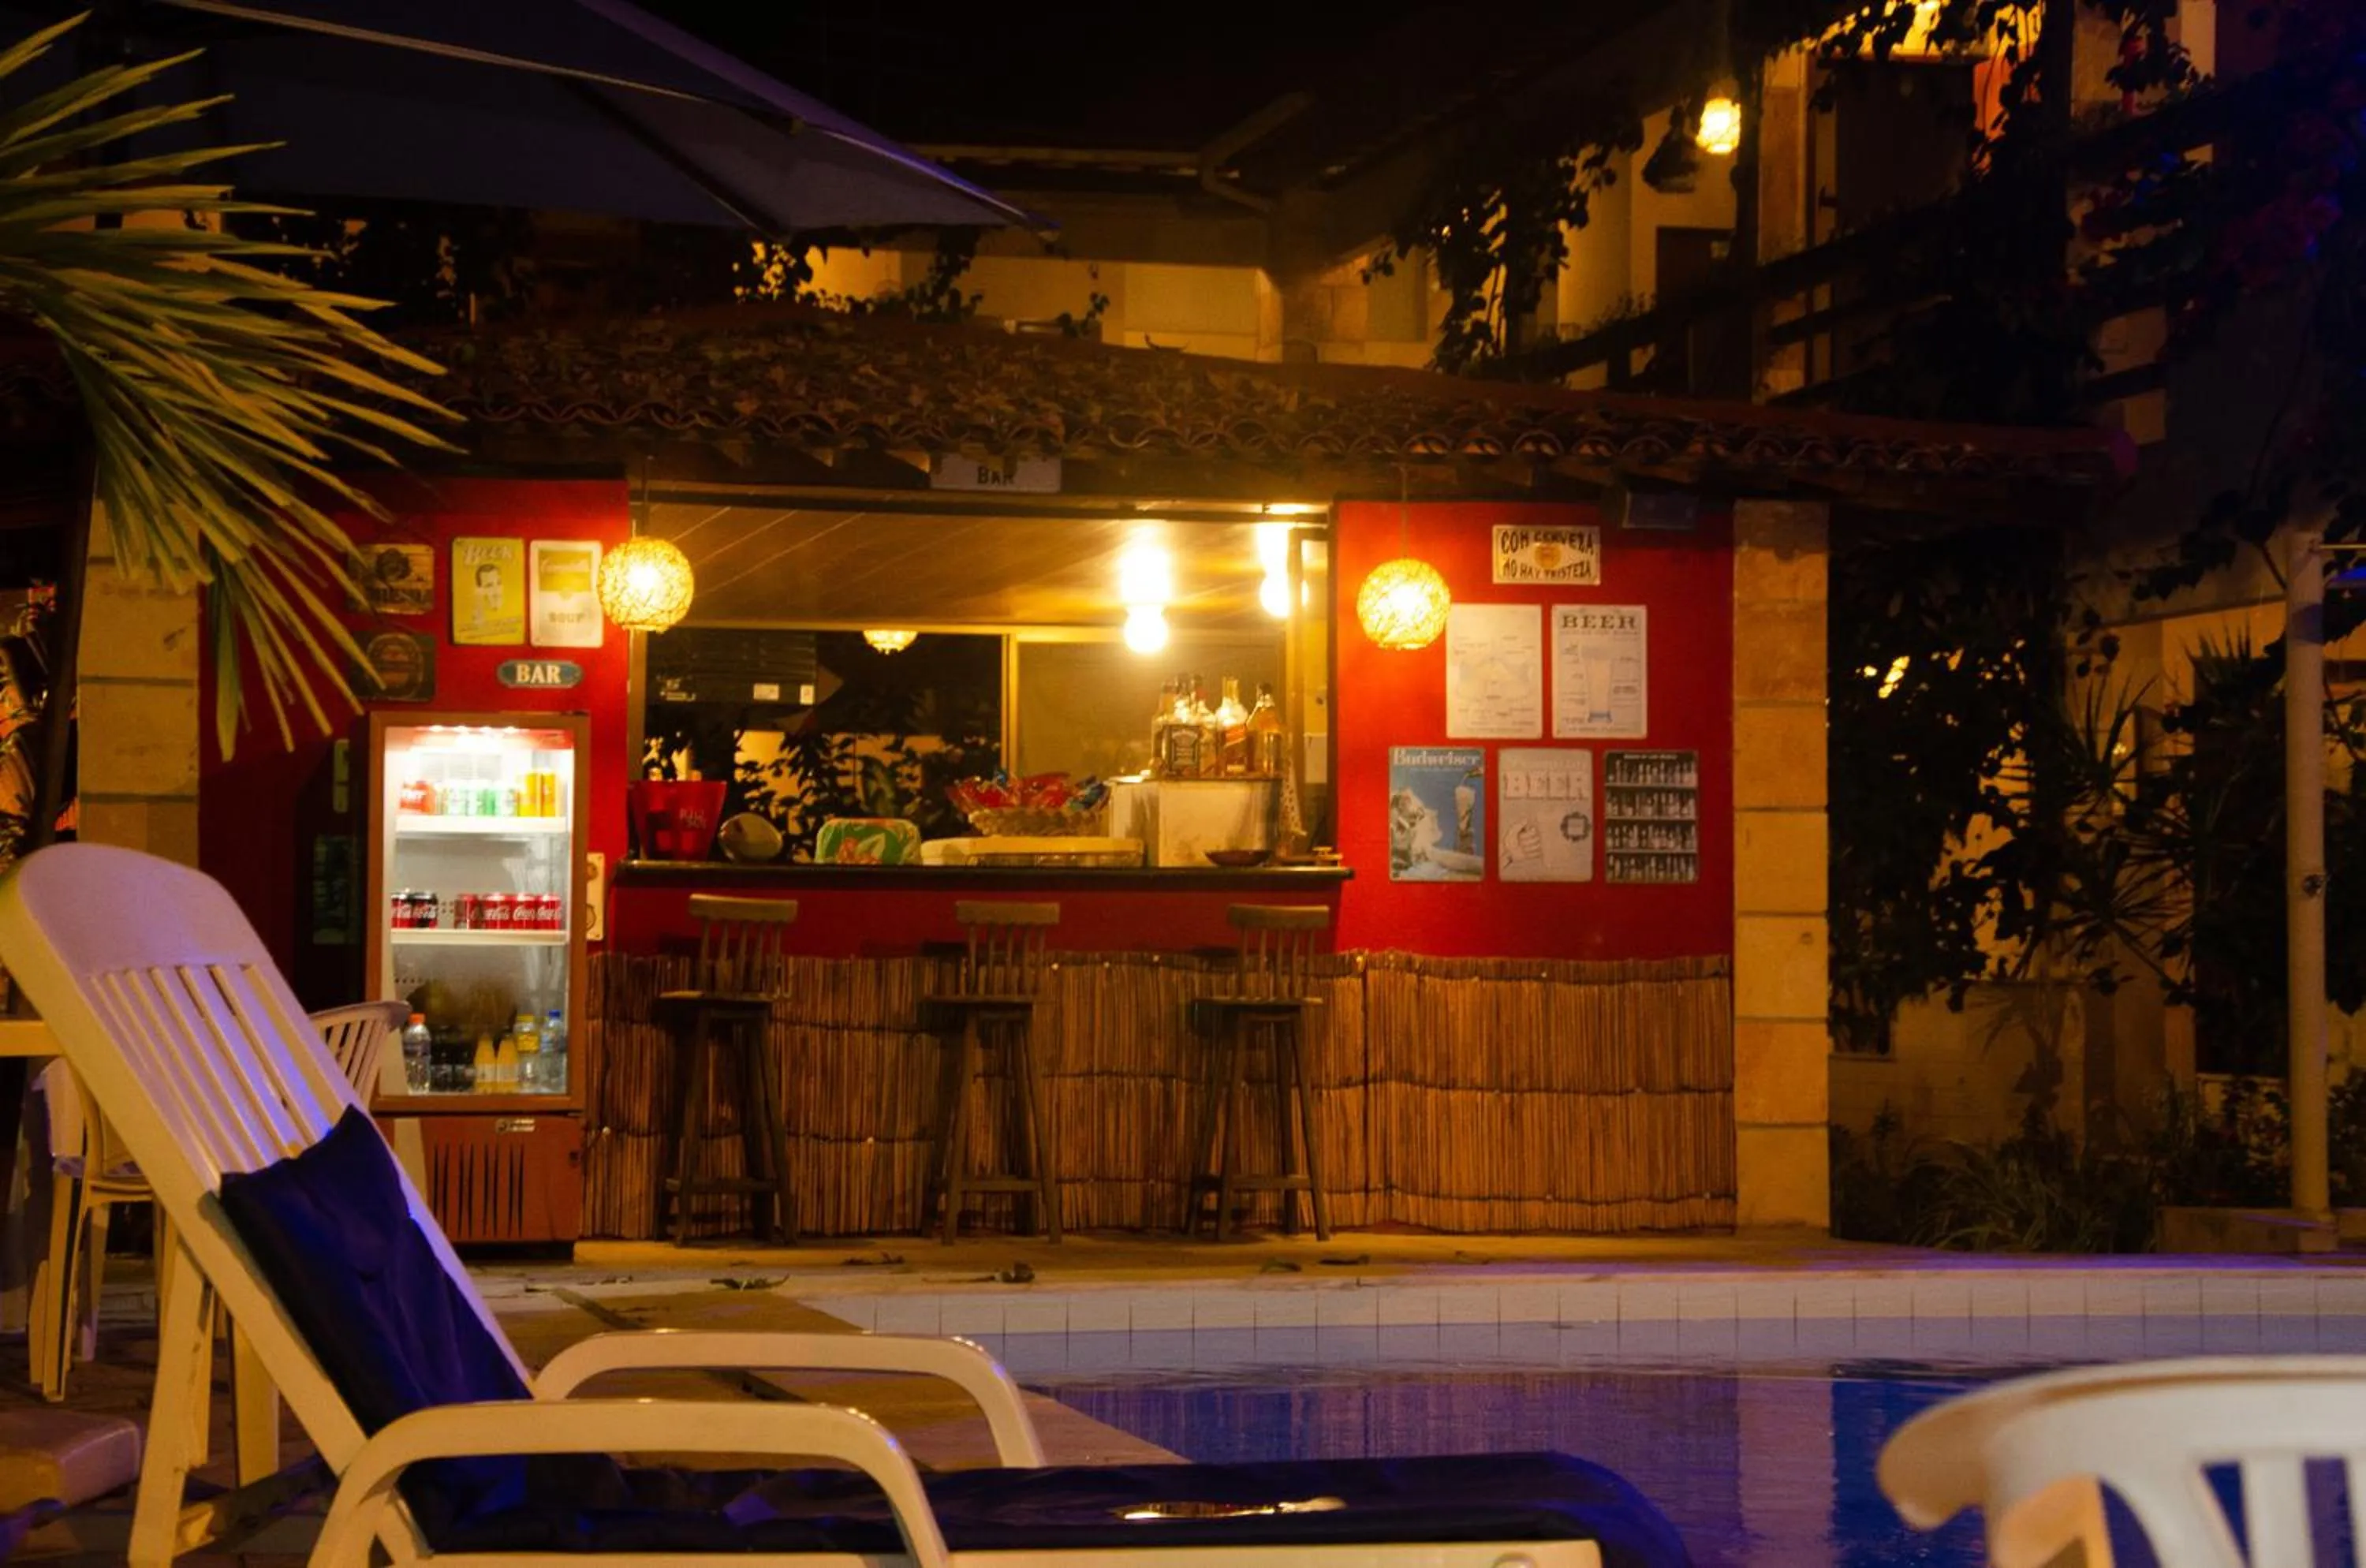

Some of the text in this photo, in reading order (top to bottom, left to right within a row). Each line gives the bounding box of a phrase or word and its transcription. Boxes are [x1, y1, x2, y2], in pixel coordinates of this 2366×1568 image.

[1562, 615, 1636, 629] BEER
[516, 663, 562, 685] BAR
[1503, 770, 1590, 801] BEER
